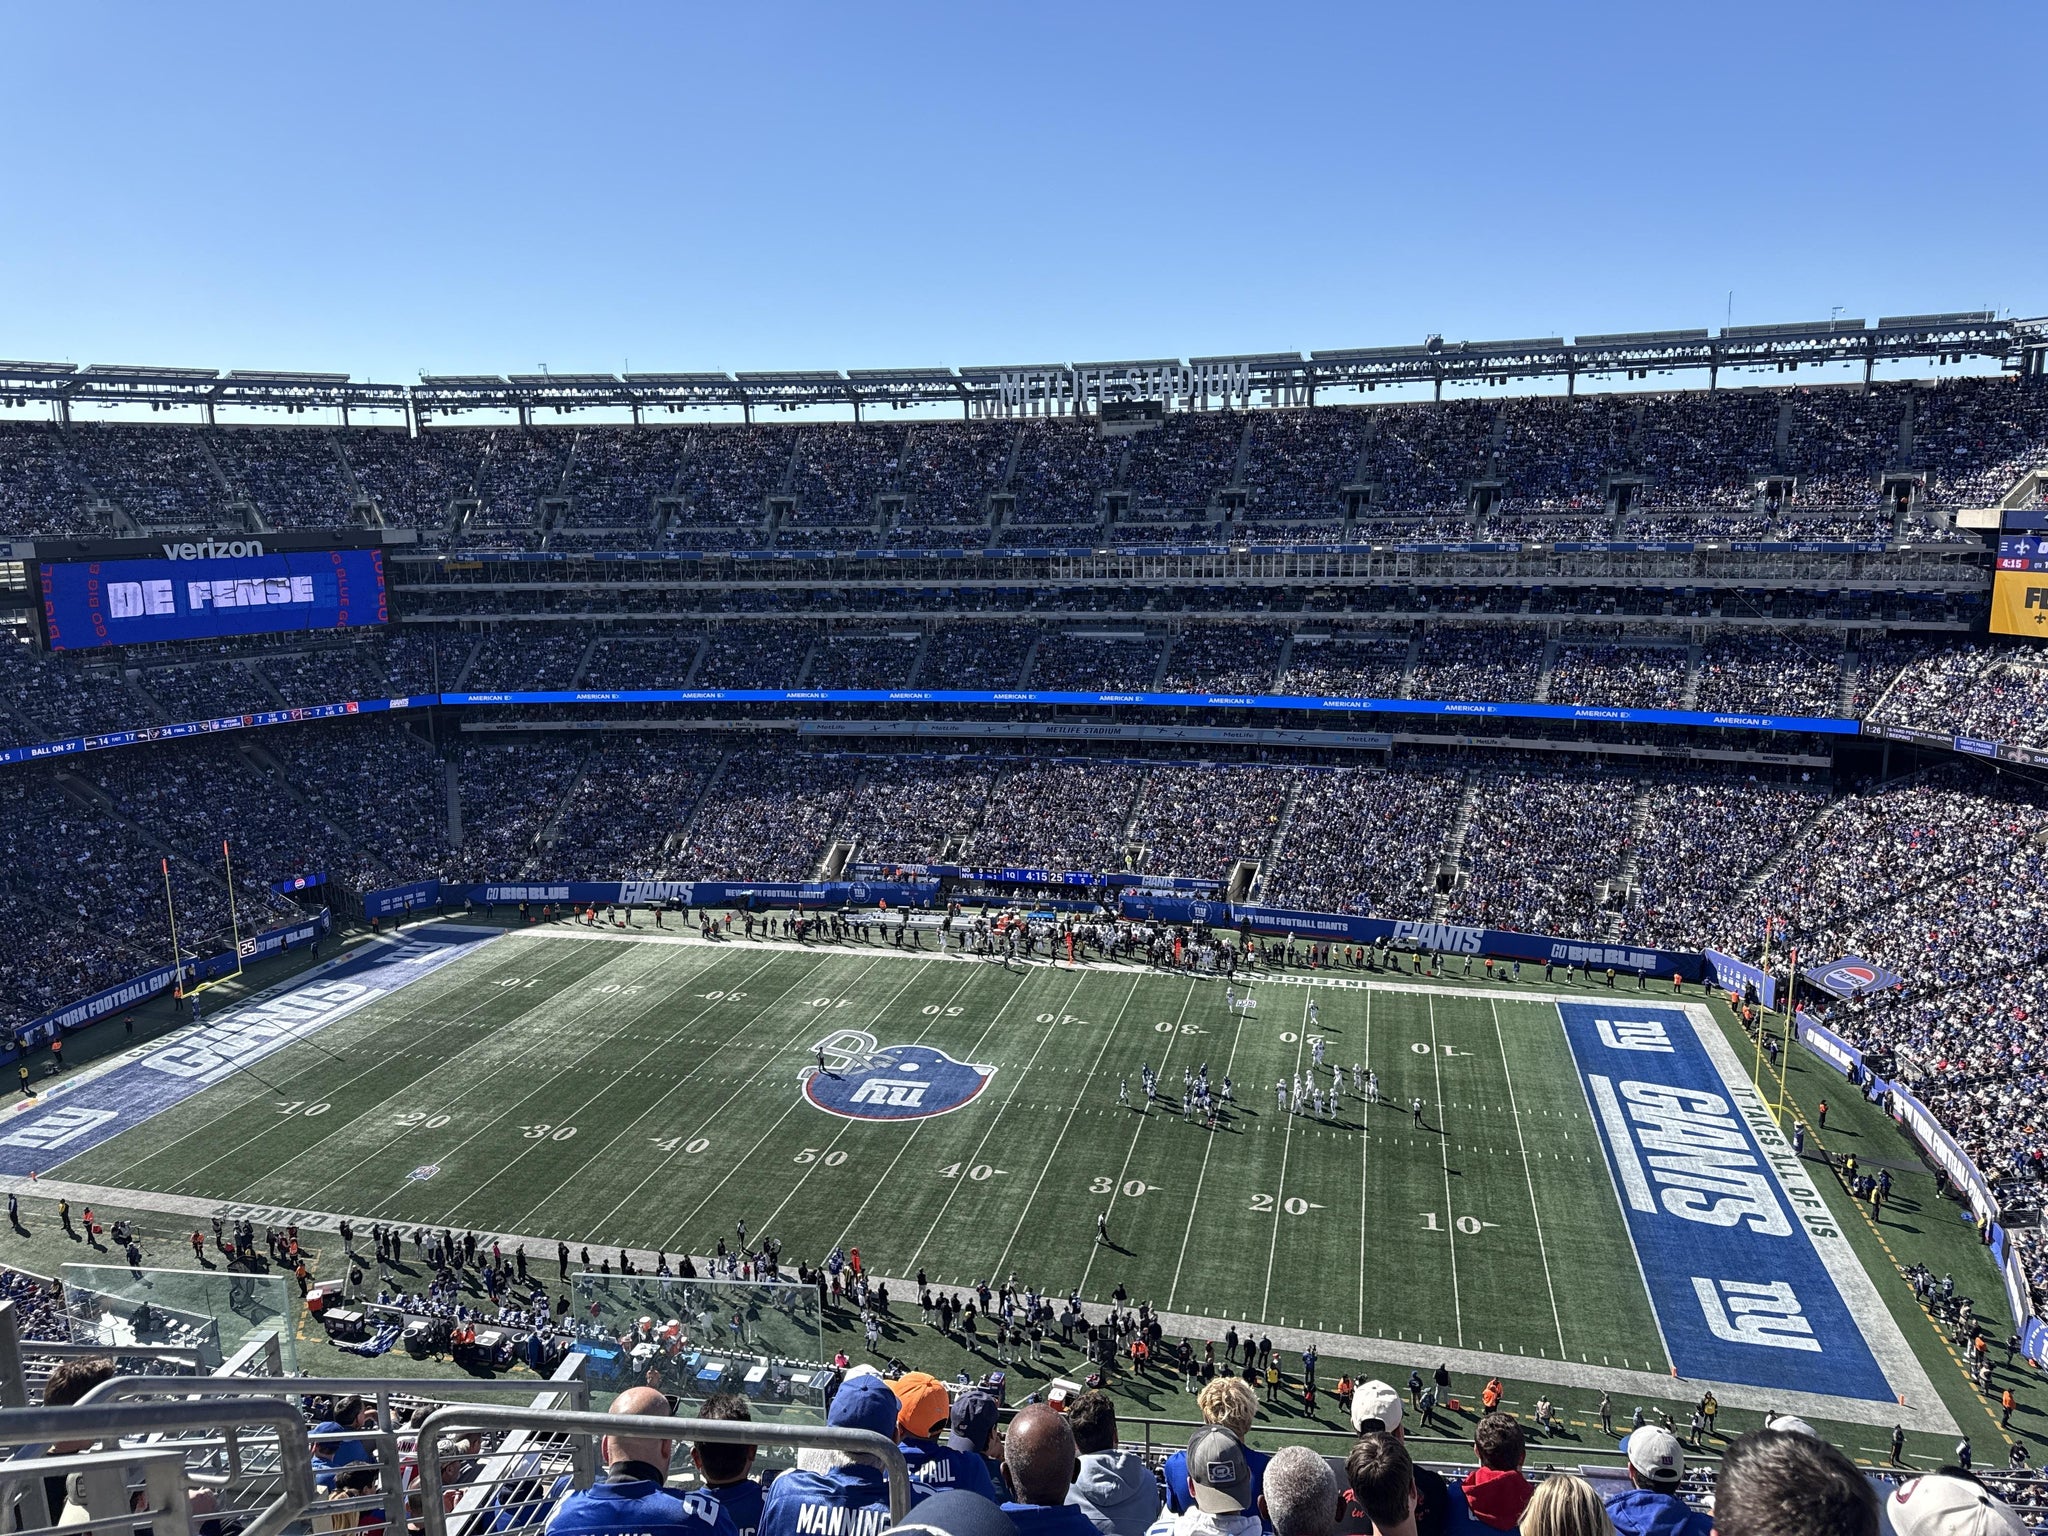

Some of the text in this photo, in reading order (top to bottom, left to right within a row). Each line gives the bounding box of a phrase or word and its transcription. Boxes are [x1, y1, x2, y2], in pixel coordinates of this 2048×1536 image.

[1000, 370, 1112, 403] METLIFE
[1126, 363, 1250, 401] STADIUM
[162, 537, 264, 561] verizon
[2002, 559, 2022, 569] 4:15
[107, 575, 315, 619] DE FENSE
[1444, 704, 1486, 712] AMERICAN
[1574, 709, 1618, 718] AMERICAN
[1713, 716, 1760, 726] AMERICAN
[161, 728, 172, 736] 34
[187, 725, 197, 733] 31
[1046, 726, 1122, 735] METLIFE STADIUM
[1865, 725, 1882, 734] 1:26
[98, 733, 135, 746] 14 17
[4, 742, 76, 760] 5 BALL ON 37
[1762, 755, 1790, 763] MOODY'S
[1005, 871, 1063, 882] 1Q 4:15 25
[1142, 876, 1175, 888] GIANTS
[486, 886, 570, 900] GO BIG BLUE
[619, 881, 695, 904] GIANTS
[763, 889, 798, 899] FOOTBALL
[798, 890, 826, 899] GIANTS
[1254, 914, 1349, 932] YORK FOOTBALL GIANTS
[285, 925, 315, 943] BLUE
[1393, 920, 1485, 954] GIANTS
[240, 941, 256, 955] 25
[1551, 943, 1657, 970] GO BIG BLUE
[504, 977, 545, 990] 10
[1834, 970, 1867, 986] PEPSI
[602, 984, 646, 996] 20
[704, 990, 749, 1002] 30
[55, 980, 149, 1032] YORK FOOTBALL
[810, 997, 854, 1010] 40
[921, 1003, 966, 1018] 50
[1036, 1011, 1082, 1026] 40
[141, 977, 370, 1079] GIANTS
[1154, 1021, 1201, 1036] 30
[1410, 1042, 1462, 1057] 10
[280, 1100, 332, 1117] 10
[399, 1111, 452, 1129] 20
[522, 1124, 579, 1142] 30
[656, 1136, 711, 1154] 40
[793, 1147, 849, 1167] 50
[1618, 1080, 1794, 1237] GIANTS
[1731, 1086, 1840, 1239] IT TAKES ALL OF US
[938, 1162, 994, 1182] 40
[1088, 1176, 1147, 1198] 30
[1249, 1193, 1309, 1216] 20
[212, 1203, 327, 1230] CANCER
[1419, 1211, 1482, 1236] 10
